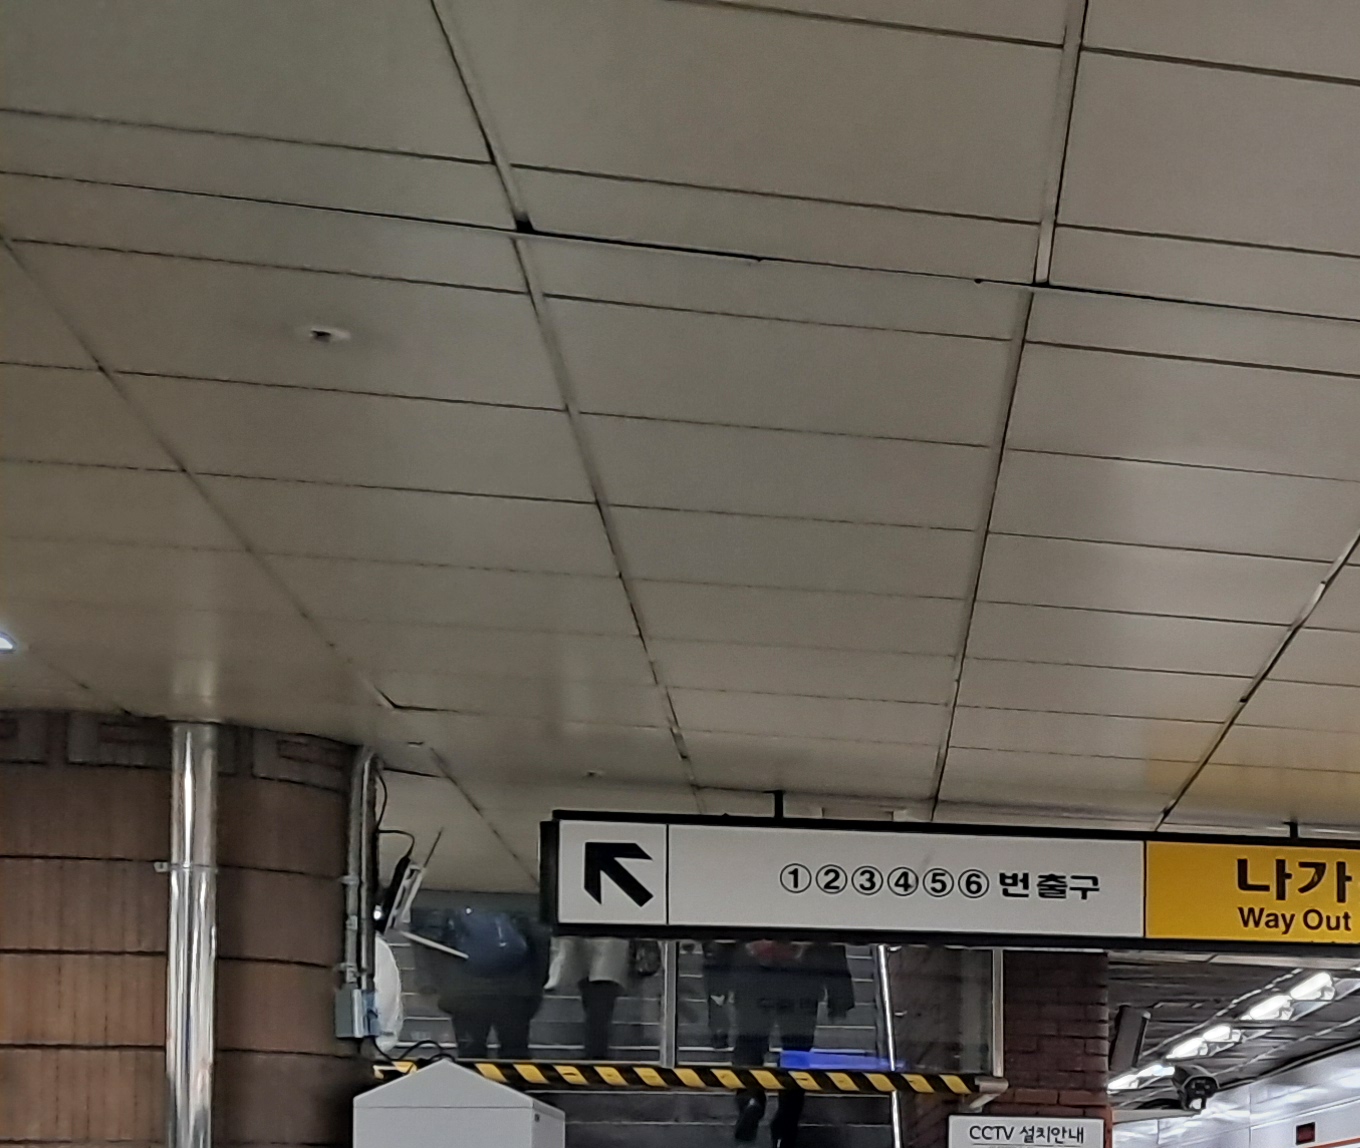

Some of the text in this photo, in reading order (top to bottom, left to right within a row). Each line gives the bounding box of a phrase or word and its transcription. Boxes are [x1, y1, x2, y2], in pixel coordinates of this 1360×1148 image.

[999, 872, 1100, 900] 번출구
[1238, 908, 1352, 934] Way Out
[969, 1126, 1084, 1144] CCTV 설치안내
